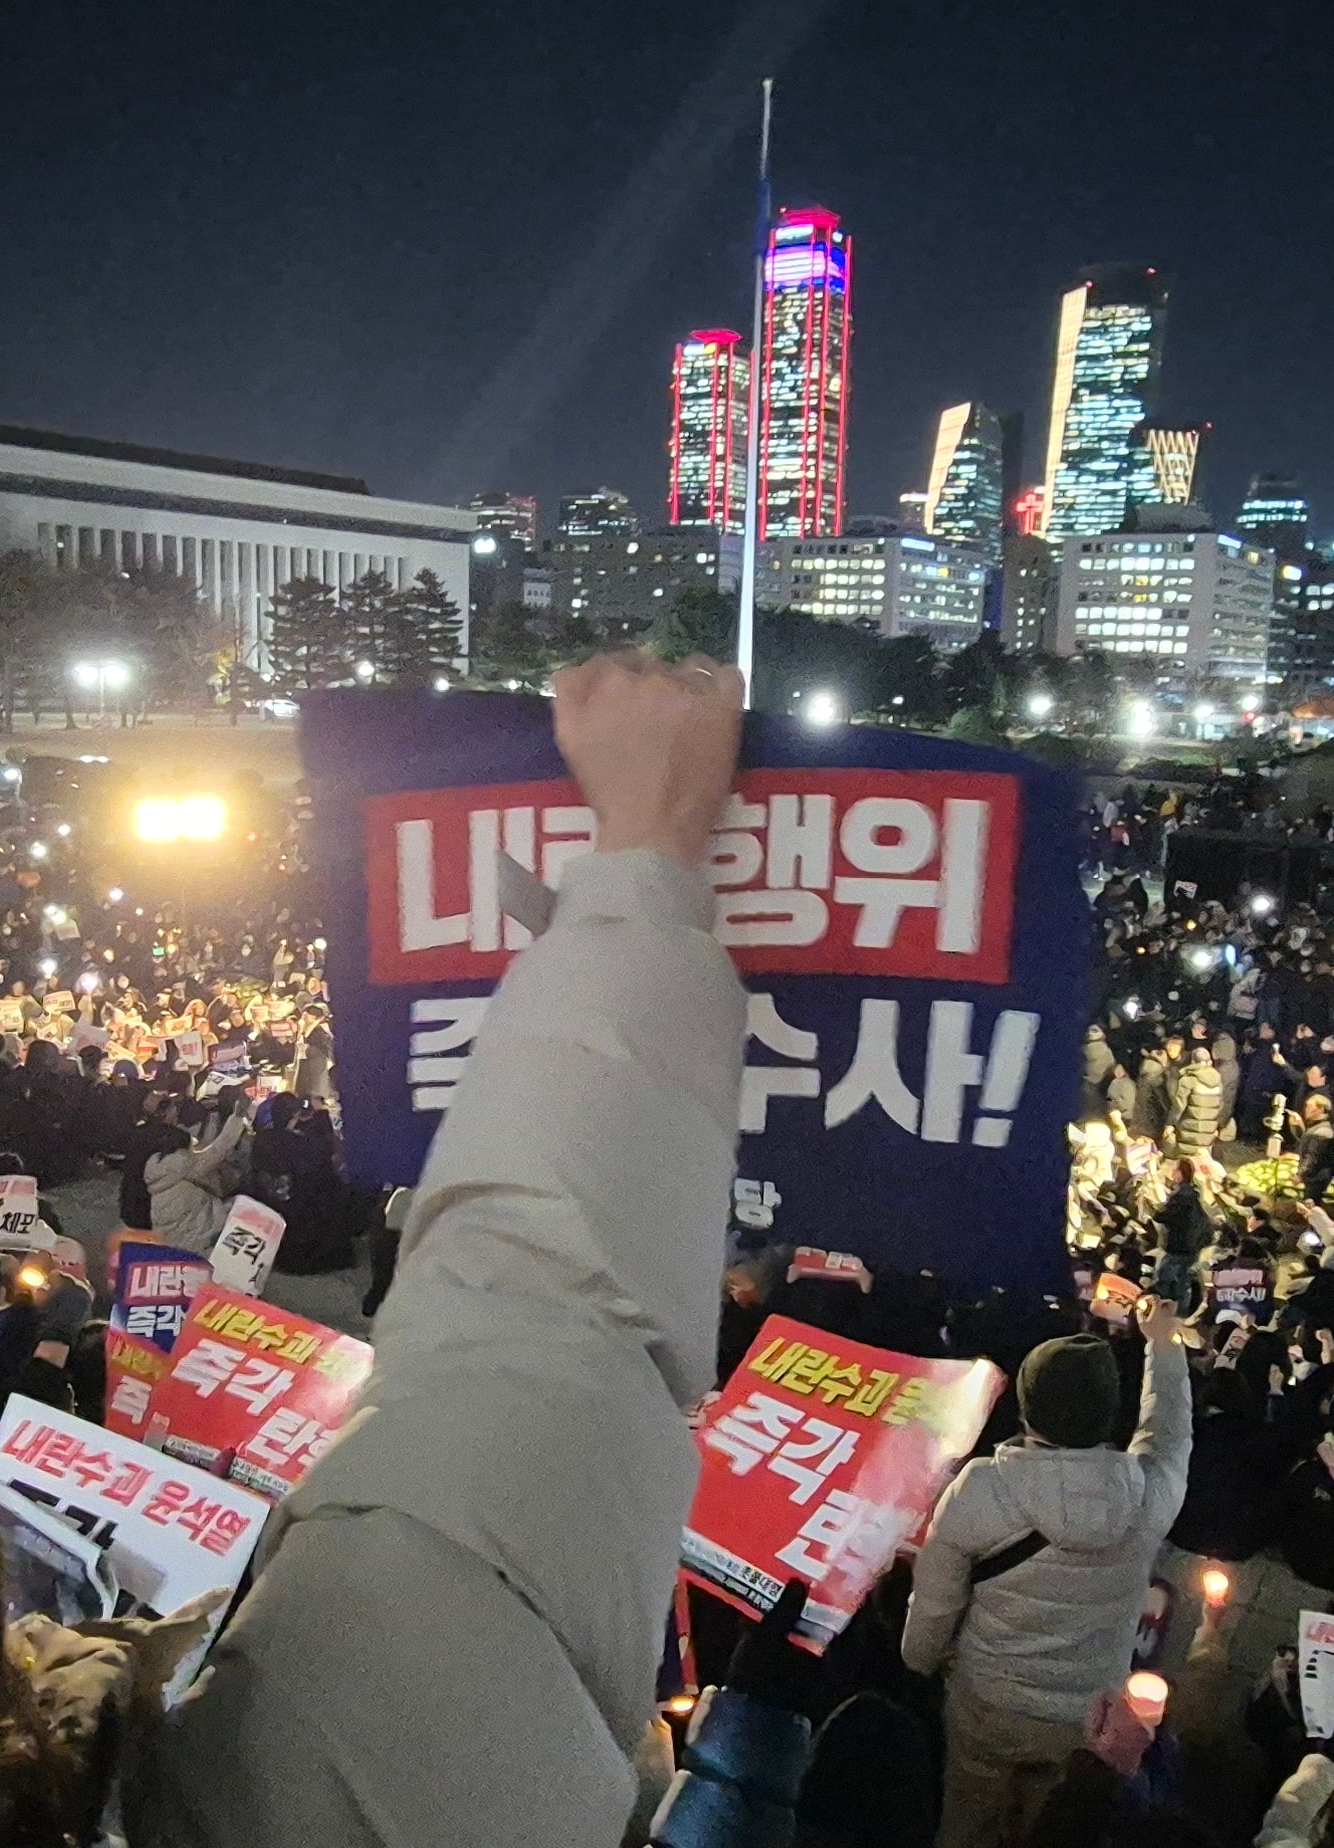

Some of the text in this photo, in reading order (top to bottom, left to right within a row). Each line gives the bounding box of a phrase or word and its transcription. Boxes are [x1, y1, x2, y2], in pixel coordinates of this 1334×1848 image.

[222, 1226, 267, 1265] 즉각
[126, 1304, 187, 1338] 즉각
[192, 1299, 323, 1366] 내란수괴
[170, 1338, 296, 1416] 즉각
[748, 1336, 900, 1417] 내란수괴
[705, 1391, 863, 1505] 즉각
[0, 1419, 155, 1507] 내란수괴
[142, 1479, 252, 1557] 윤석열
